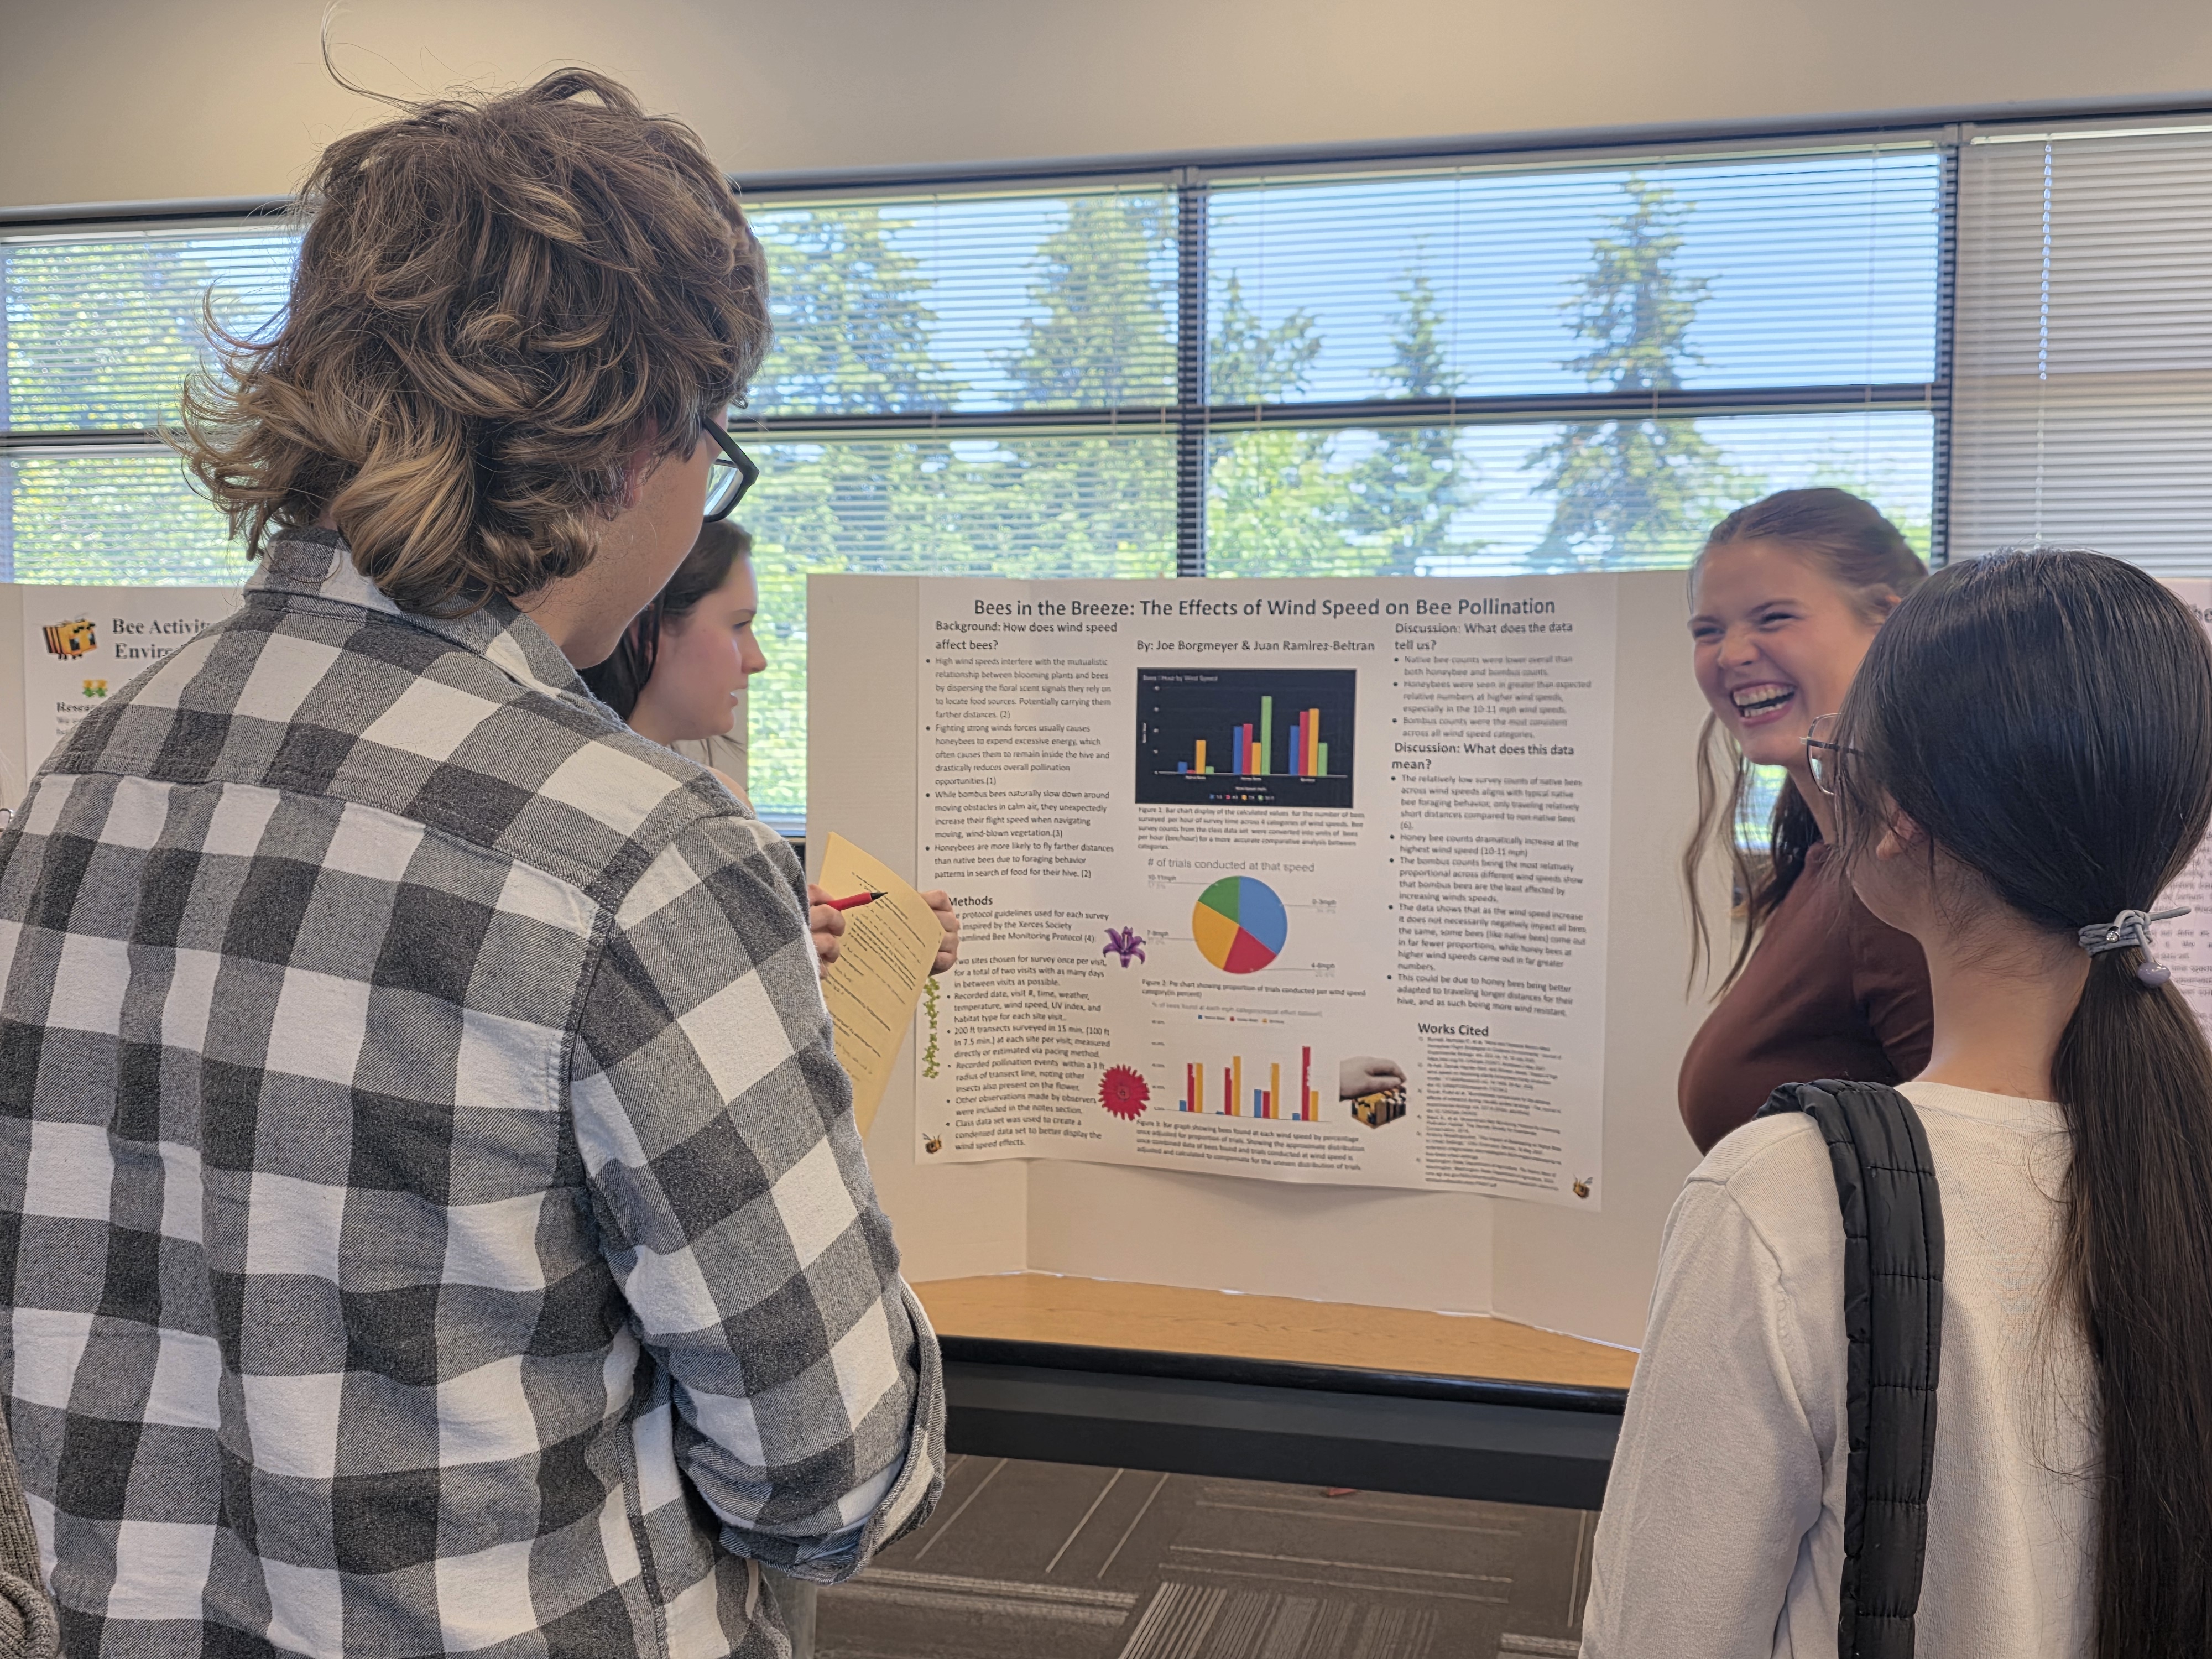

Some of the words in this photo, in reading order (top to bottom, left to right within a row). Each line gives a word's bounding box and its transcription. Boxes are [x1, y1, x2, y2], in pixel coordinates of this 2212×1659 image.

[975, 600, 1012, 615] Bees
[1018, 600, 1032, 615] in
[1038, 600, 1066, 615] the
[1072, 601, 1134, 615] Breeze:
[1140, 599, 1172, 615] The
[1179, 599, 1237, 615] Effects
[1243, 599, 1262, 615] of
[1267, 599, 1316, 615] Wind
[1322, 599, 1379, 619] Speed
[1386, 603, 1408, 615] on
[1417, 599, 1452, 615] Bee
[1459, 598, 1555, 615] Pollination
[113, 618, 144, 634] Bee
[936, 621, 1000, 633] Background:
[1003, 622, 1026, 632] How
[1029, 622, 1054, 632] does
[1057, 622, 1083, 632] wind
[1086, 622, 1117, 633] speed
[1396, 623, 1460, 634] Discussion:
[1464, 623, 1497, 633] What
[1500, 623, 1526, 634] does
[1528, 622, 1546, 633] the
[1549, 622, 1573, 633] data
[936, 639, 966, 649] affect
[969, 640, 998, 650] bees?
[1137, 640, 1153, 652] By:
[1156, 641, 1175, 650] Joe
[1178, 640, 1238, 653] Borgmeyer
[1242, 640, 1250, 650] &
[1254, 641, 1279, 650] Juan
[1395, 640, 1413, 650] tell
[1417, 640, 1437, 650] us?
[1395, 742, 1460, 753] Discussion:
[1464, 743, 1496, 754] What
[1499, 743, 1525, 755] does
[1528, 744, 1547, 755] this
[1551, 744, 1574, 755] data
[1392, 759, 1431, 769] mean?
[1156, 858, 1166, 867] of
[1168, 858, 1191, 868] trials
[1194, 860, 1245, 869] conducted
[1260, 862, 1280, 871] that
[1283, 863, 1314, 873] speed
[1418, 1023, 1455, 1035] Works
[1459, 1025, 1489, 1037] Cited
